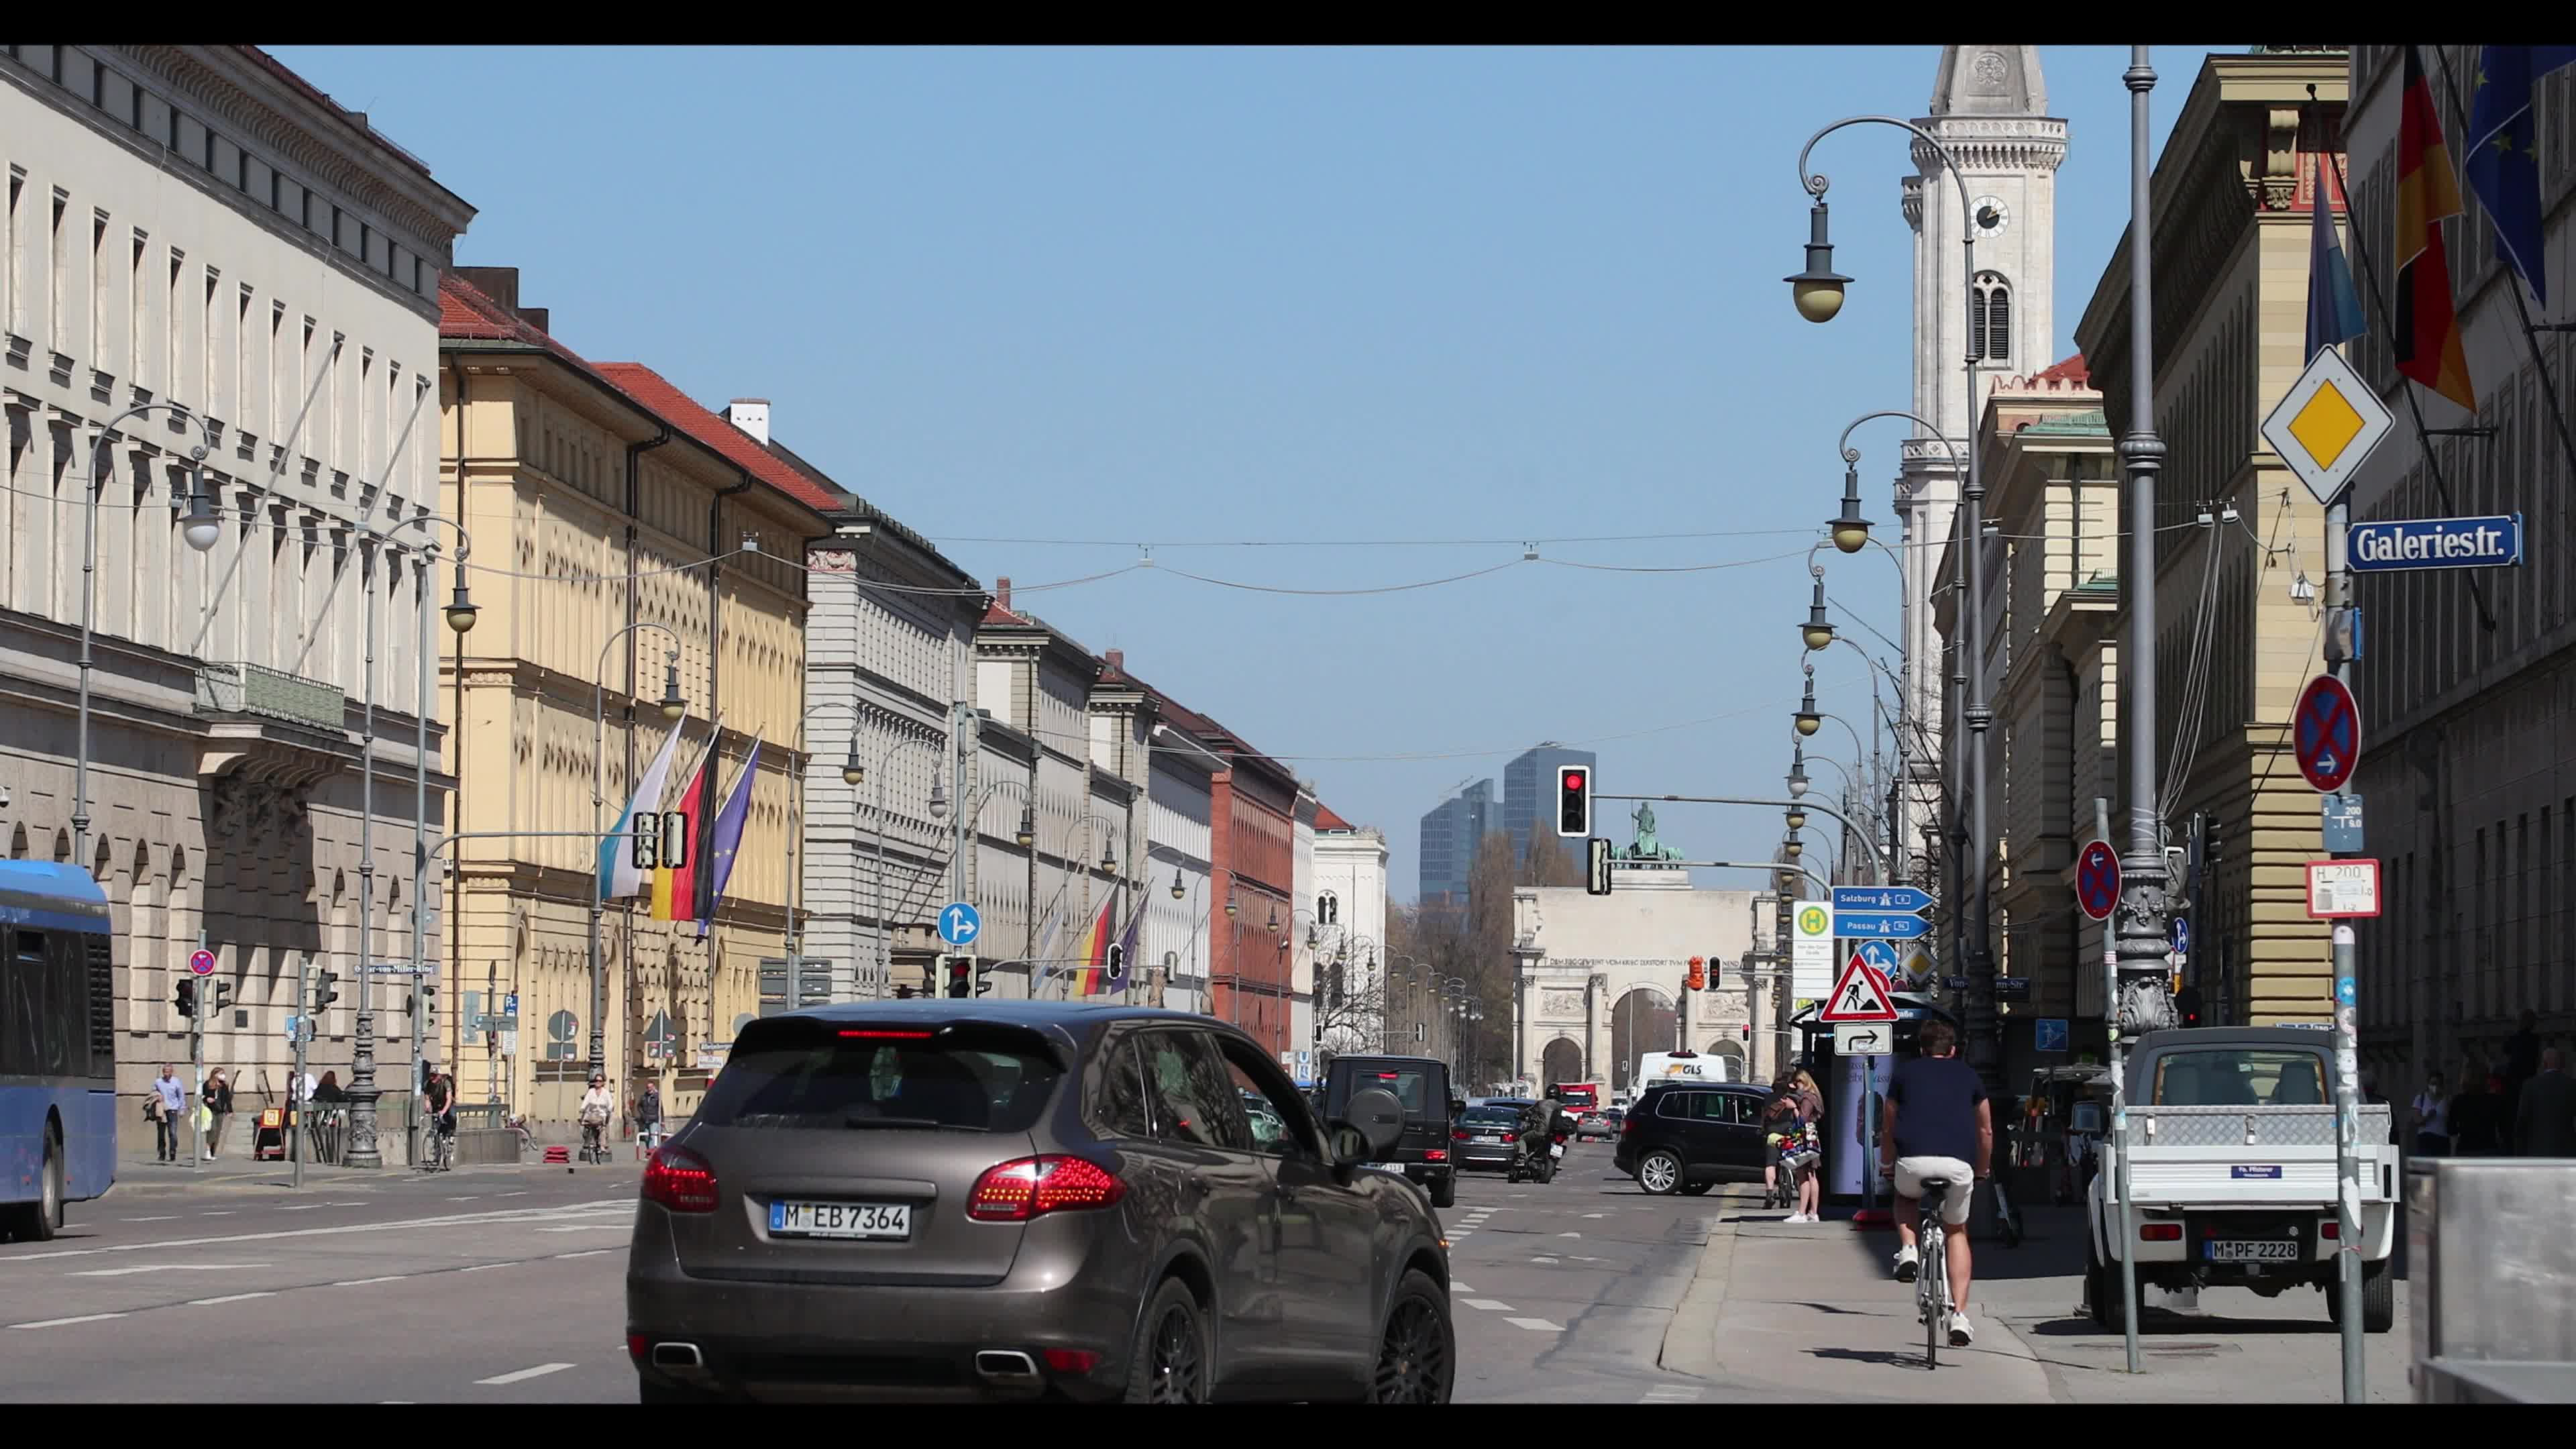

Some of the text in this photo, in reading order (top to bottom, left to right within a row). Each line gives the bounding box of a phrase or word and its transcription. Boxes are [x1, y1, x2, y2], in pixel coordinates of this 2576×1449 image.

[2357, 525, 2505, 561] Galeriestr.
[2345, 806, 2362, 816] 200
[2316, 866, 2361, 879] H 200
[1840, 894, 1876, 904] Salzburg
[1807, 913, 1821, 929] H
[1847, 922, 1876, 930] Passau
[505, 997, 513, 1008] P
[1299, 1051, 1309, 1063] U
[1682, 1064, 1703, 1075] GLS
[784, 1203, 799, 1227] M
[814, 1205, 843, 1228] EB
[848, 1205, 905, 1230] 7364
[2214, 1242, 2296, 1258] M PF 2228
